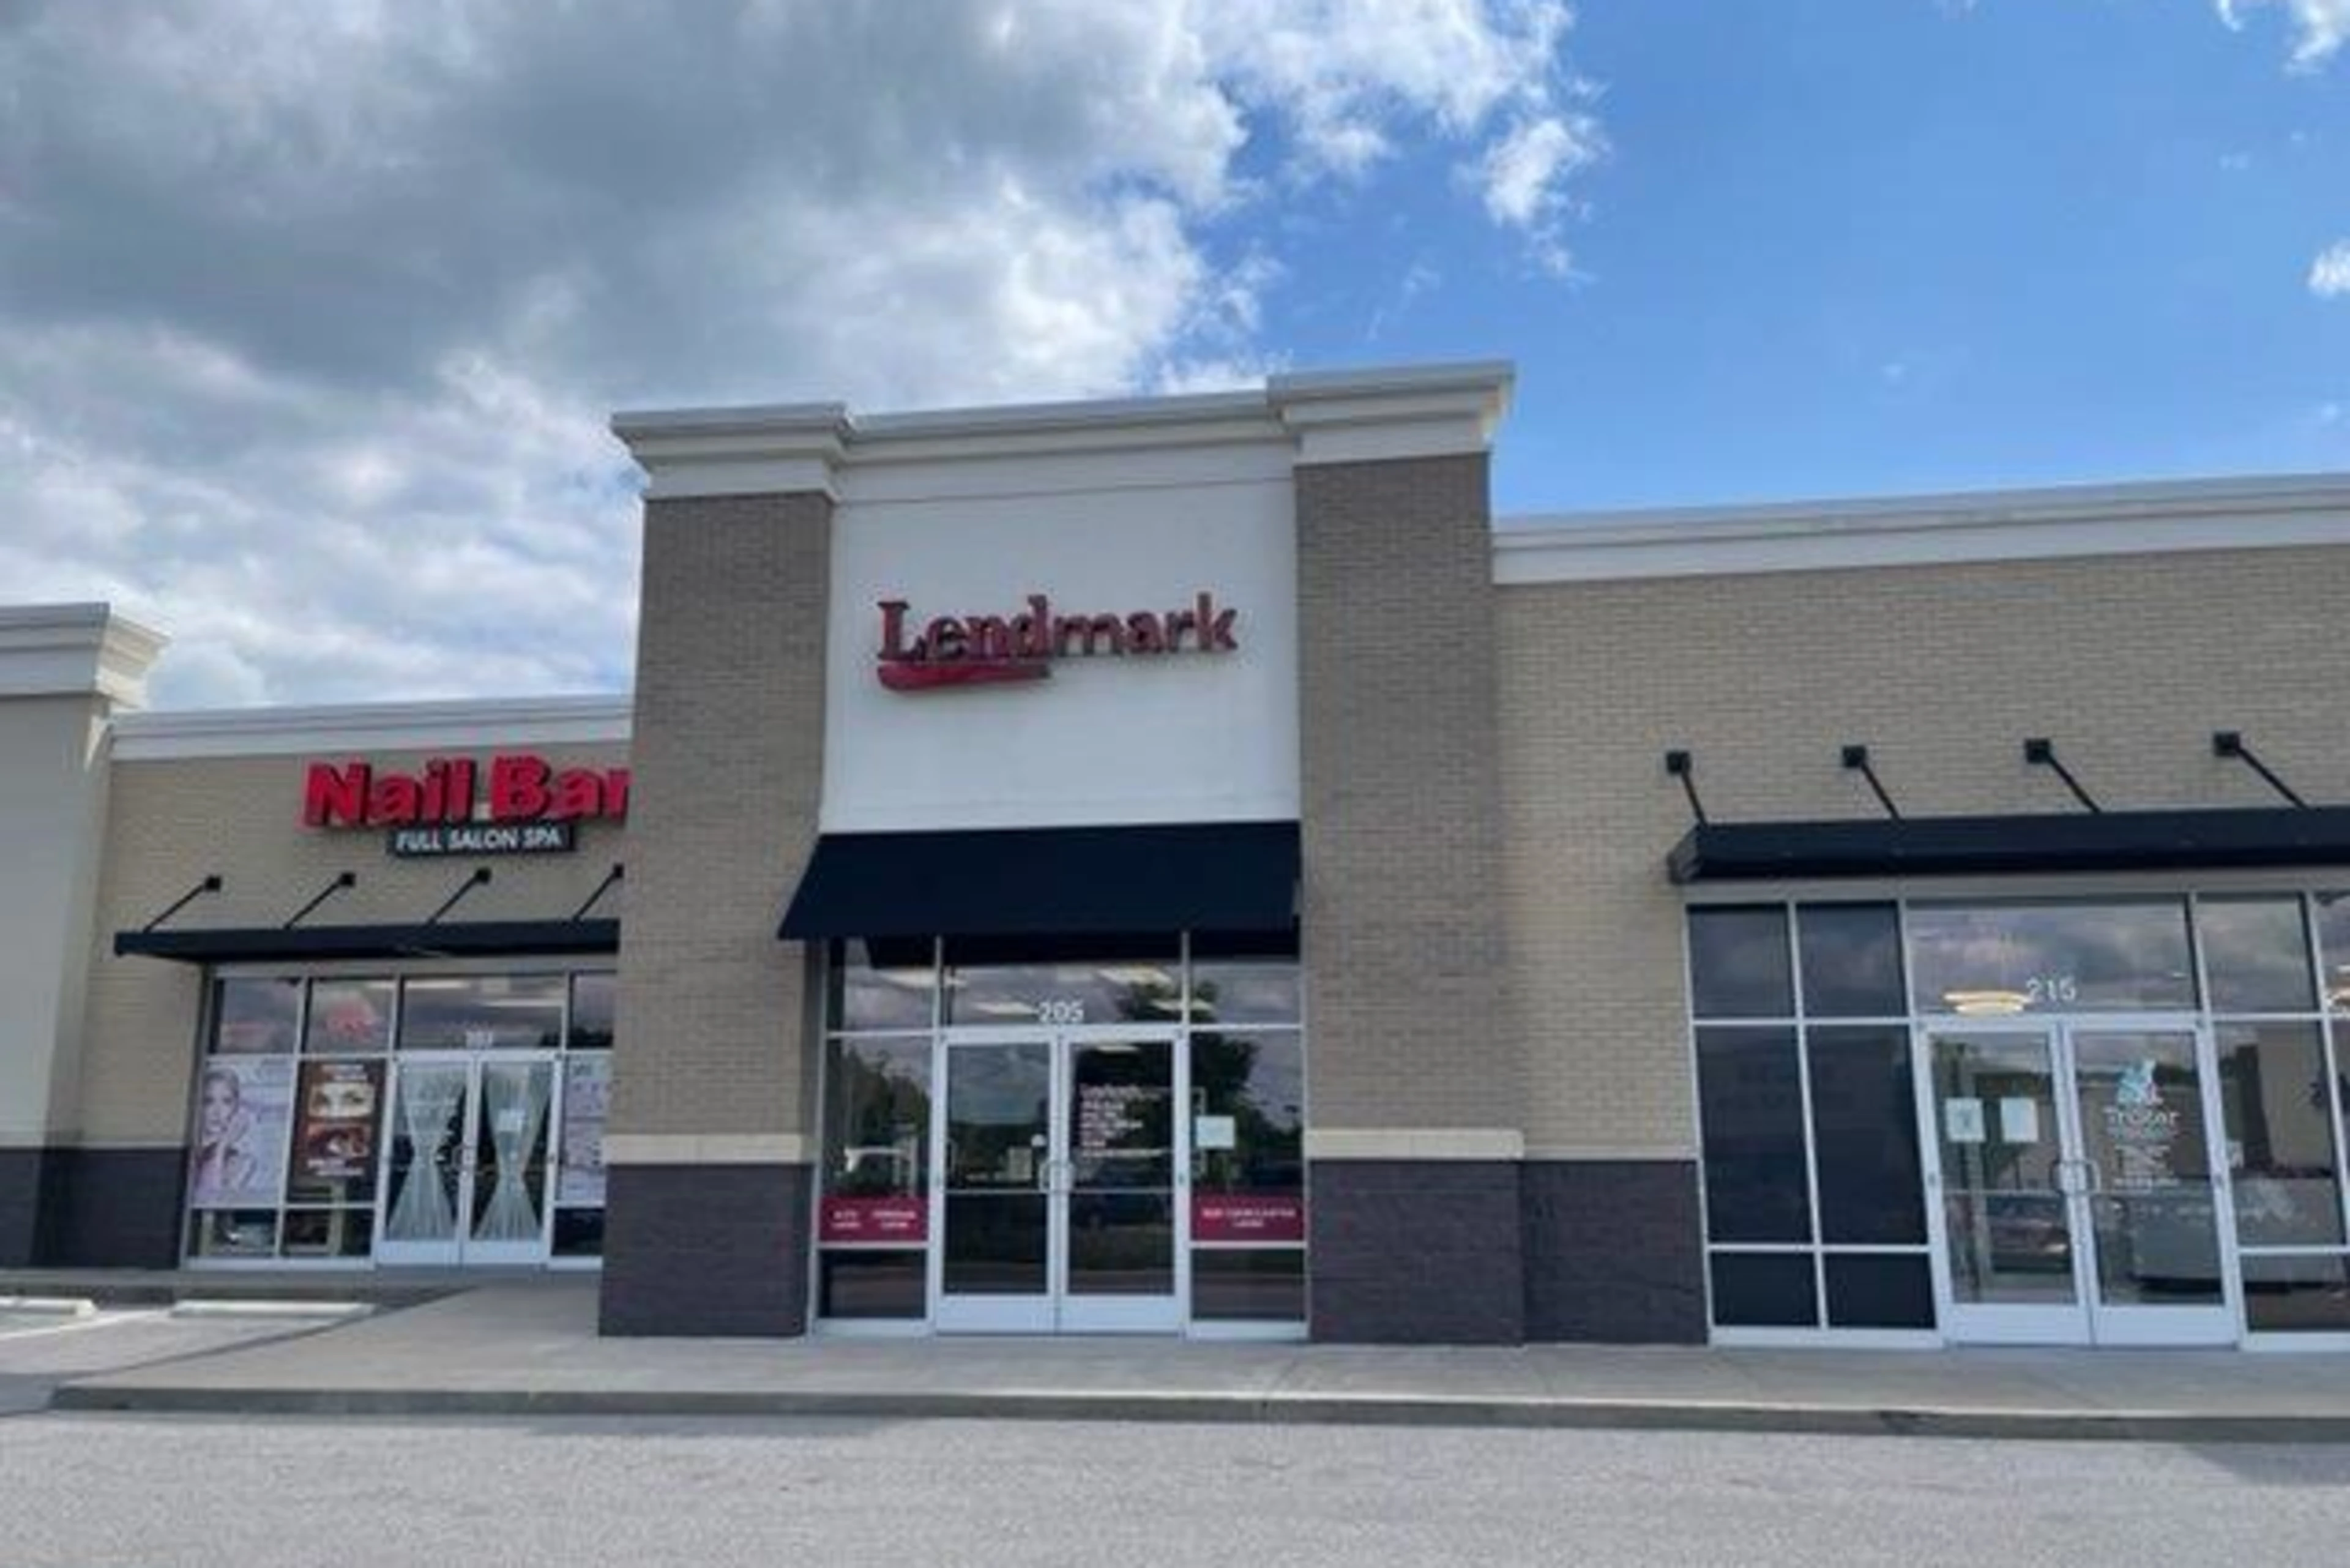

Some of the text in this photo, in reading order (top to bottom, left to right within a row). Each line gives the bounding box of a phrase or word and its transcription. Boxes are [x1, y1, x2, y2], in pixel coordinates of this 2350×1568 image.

[876, 591, 1238, 661] Lendmark
[305, 755, 630, 827] Nail Bar
[395, 827, 561, 850] FULL SALON SPA
[1039, 999, 1084, 1023] 205
